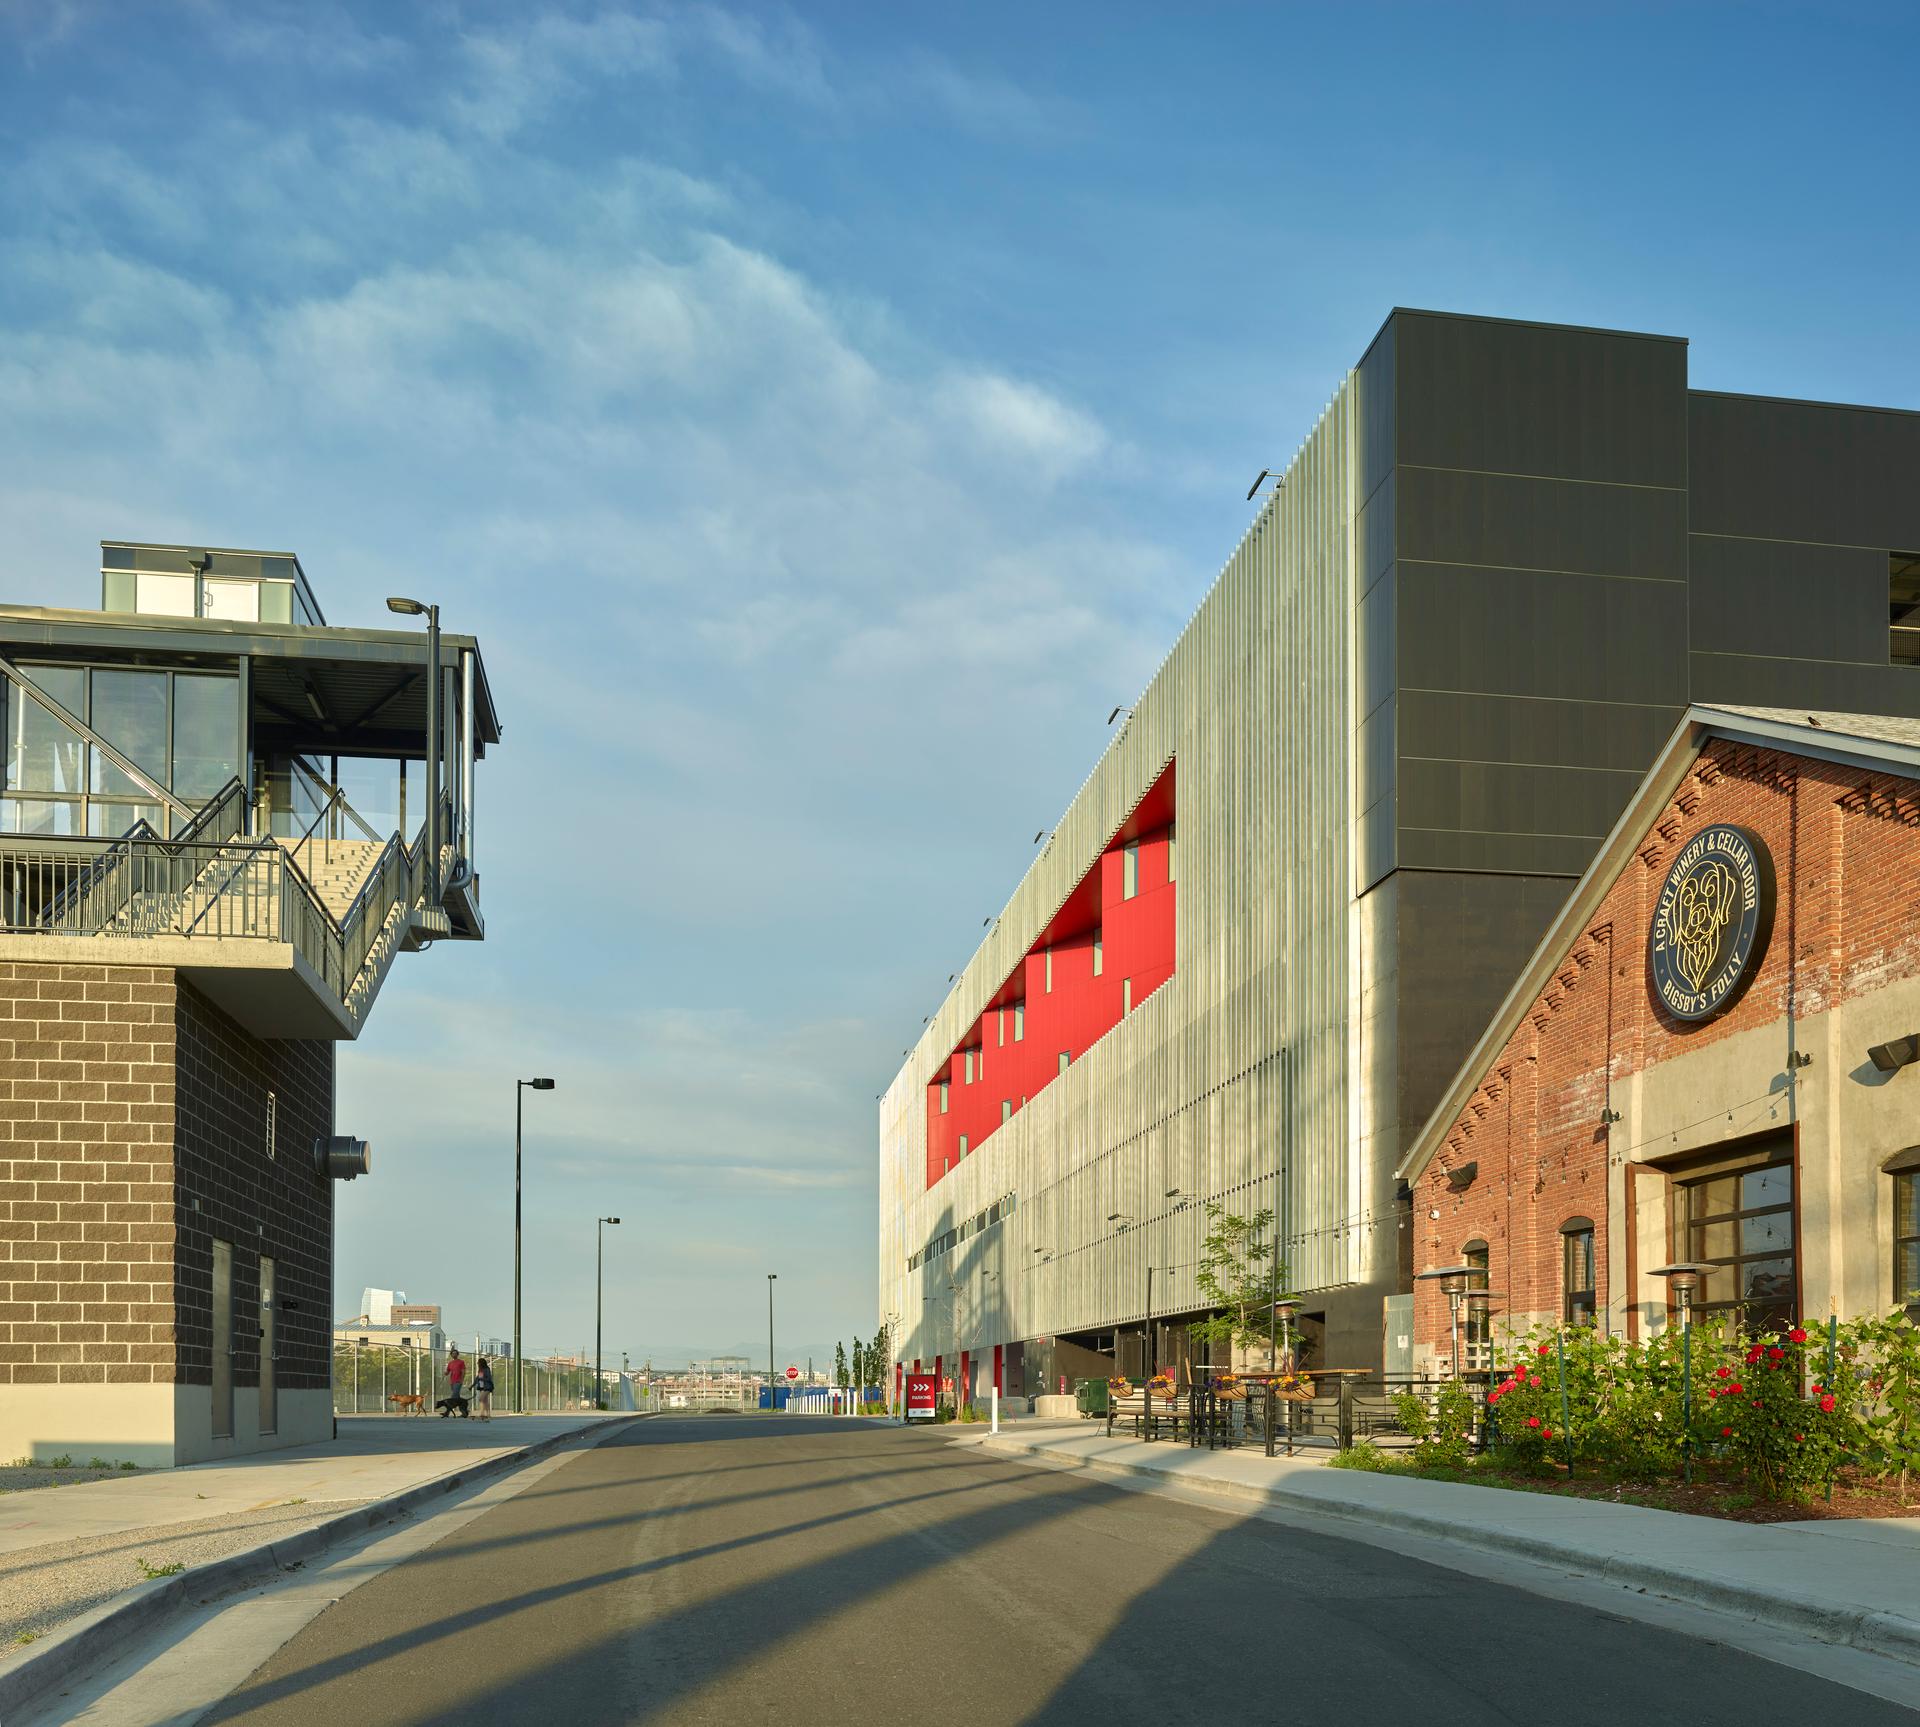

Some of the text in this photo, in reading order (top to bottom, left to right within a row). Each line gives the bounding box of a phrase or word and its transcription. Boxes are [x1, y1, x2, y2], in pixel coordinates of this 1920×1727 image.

[1656, 887, 1674, 939] CRAFT
[1670, 837, 1705, 887] WINERY
[1707, 833, 1715, 851] &
[1717, 832, 1749, 869] CELLAR
[1742, 863, 1756, 911] DOOR
[1663, 951, 1742, 1012] BIGSBY'S FOLLY
